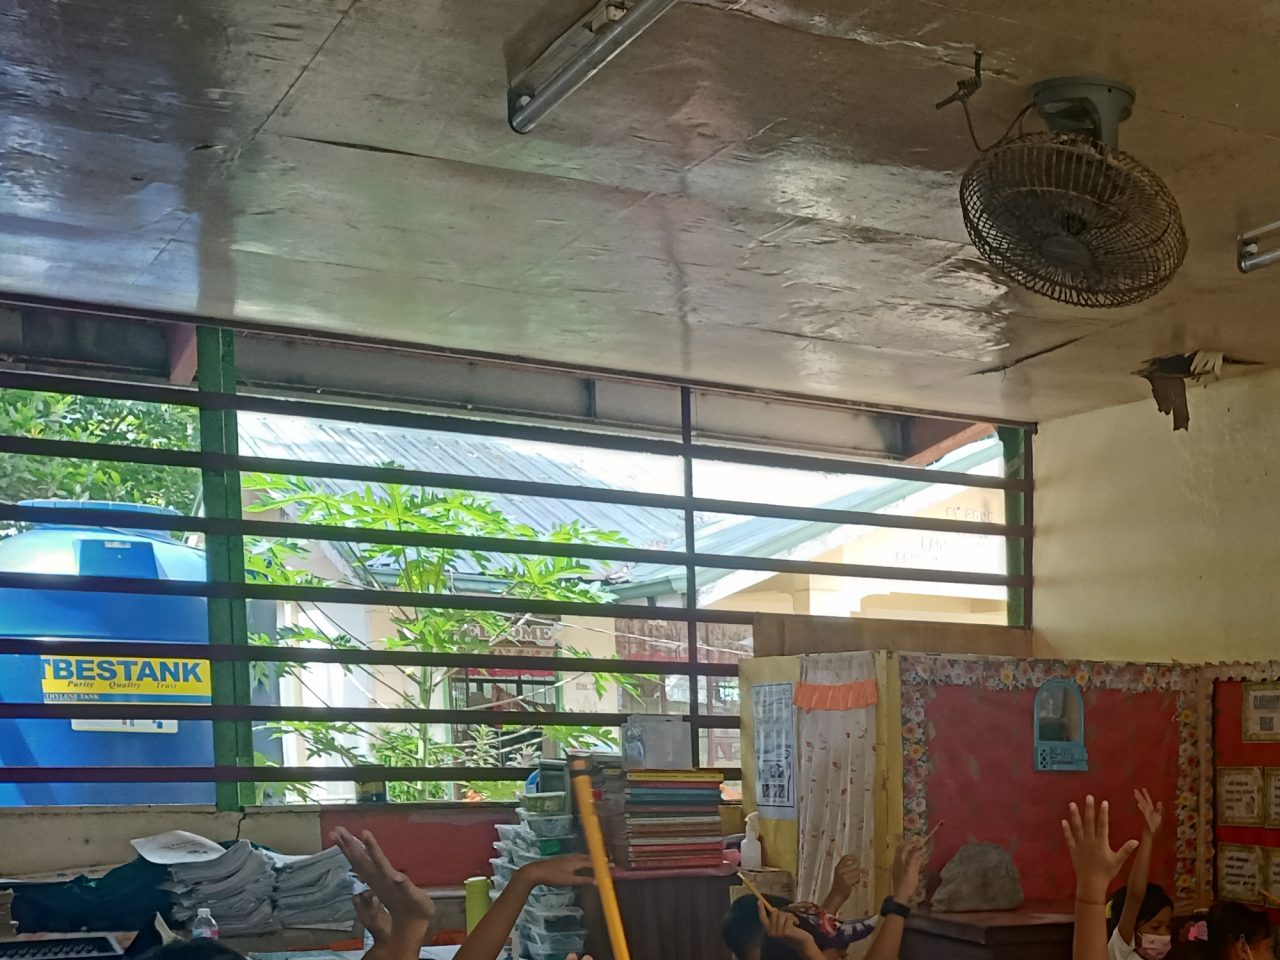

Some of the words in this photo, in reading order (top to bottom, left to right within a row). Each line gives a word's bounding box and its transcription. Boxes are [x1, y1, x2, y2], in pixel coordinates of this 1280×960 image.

[53, 659, 203, 683] BESTANK
[67, 681, 95, 689] Purity
[109, 681, 141, 689] Quality
